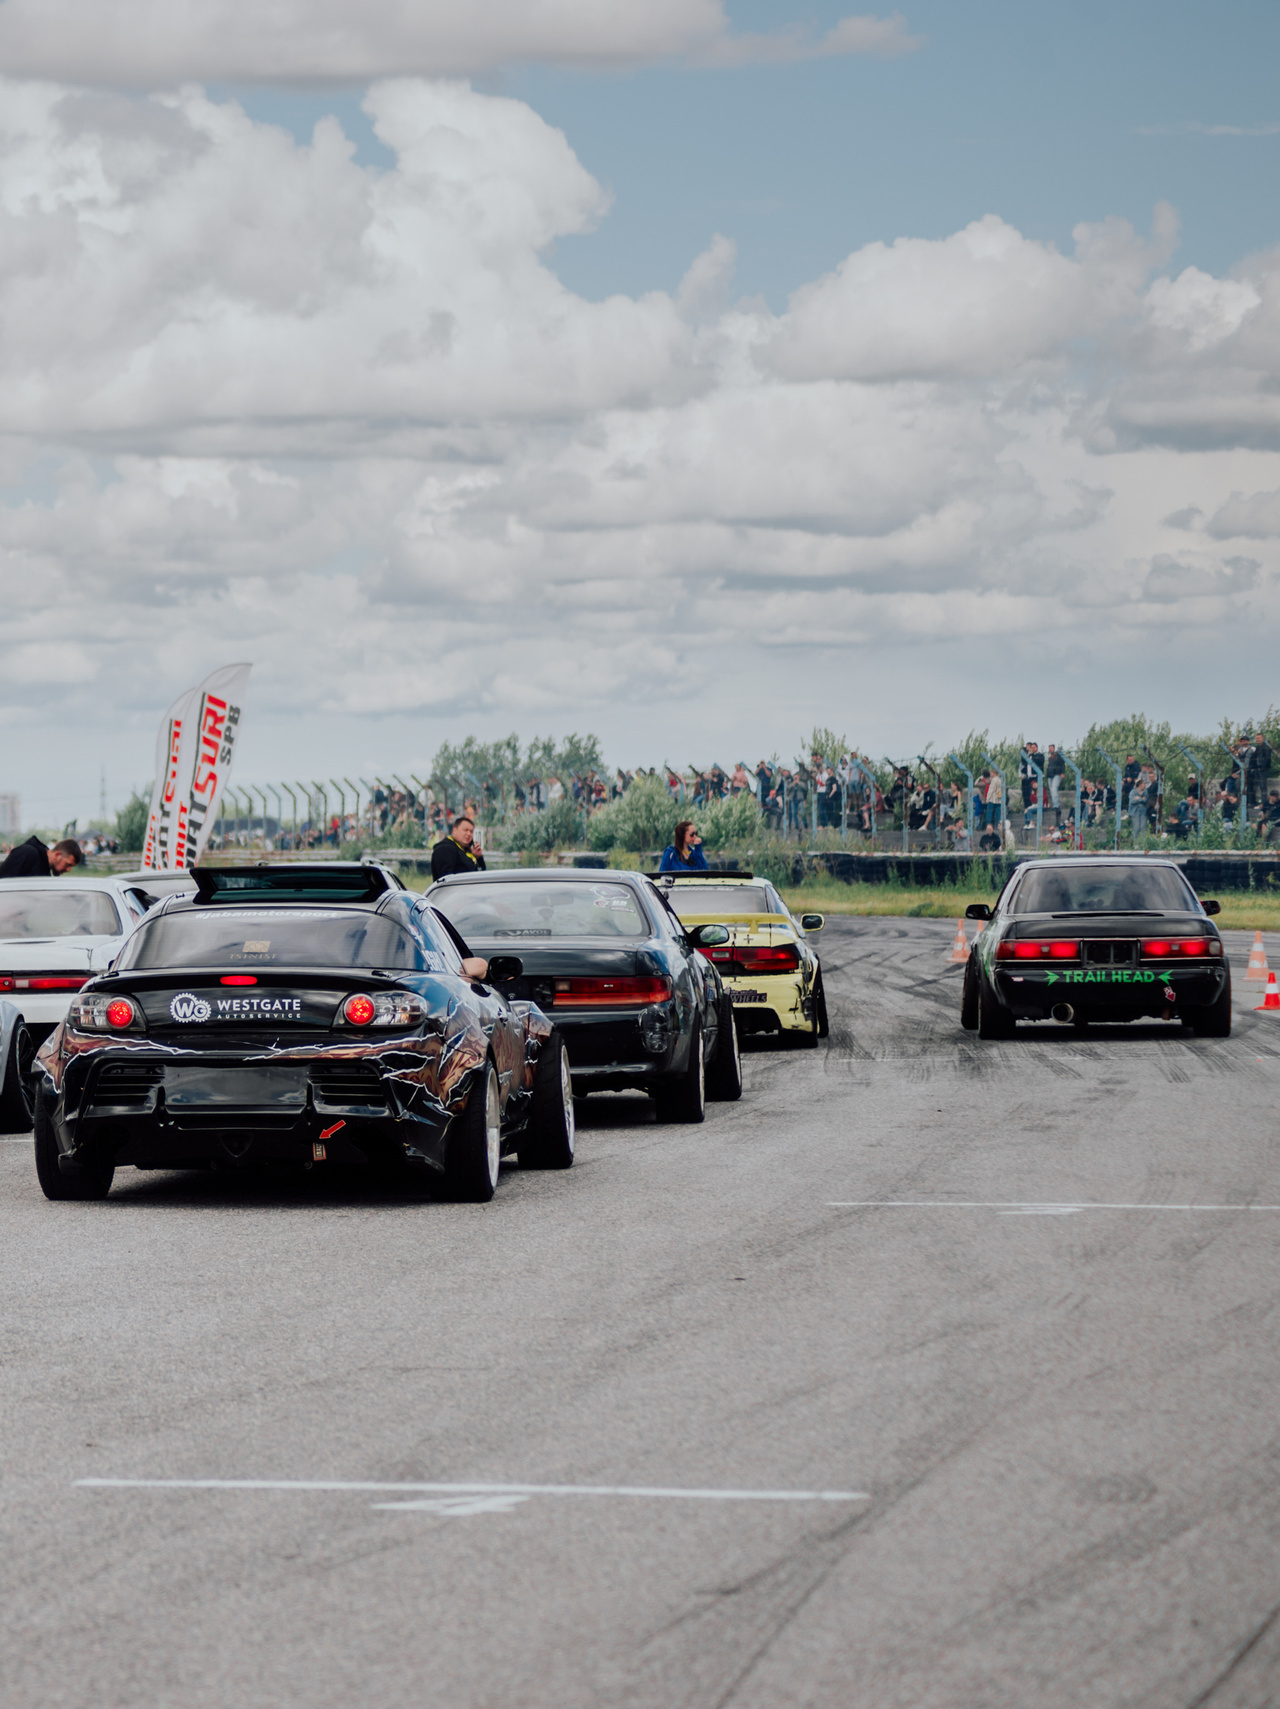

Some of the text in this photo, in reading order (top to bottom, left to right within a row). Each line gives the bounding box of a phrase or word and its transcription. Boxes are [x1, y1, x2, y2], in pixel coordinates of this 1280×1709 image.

[219, 703, 241, 766] SPB
[1063, 971, 1155, 983] TRAILHEAD
[217, 999, 301, 1011] WESTGATE
